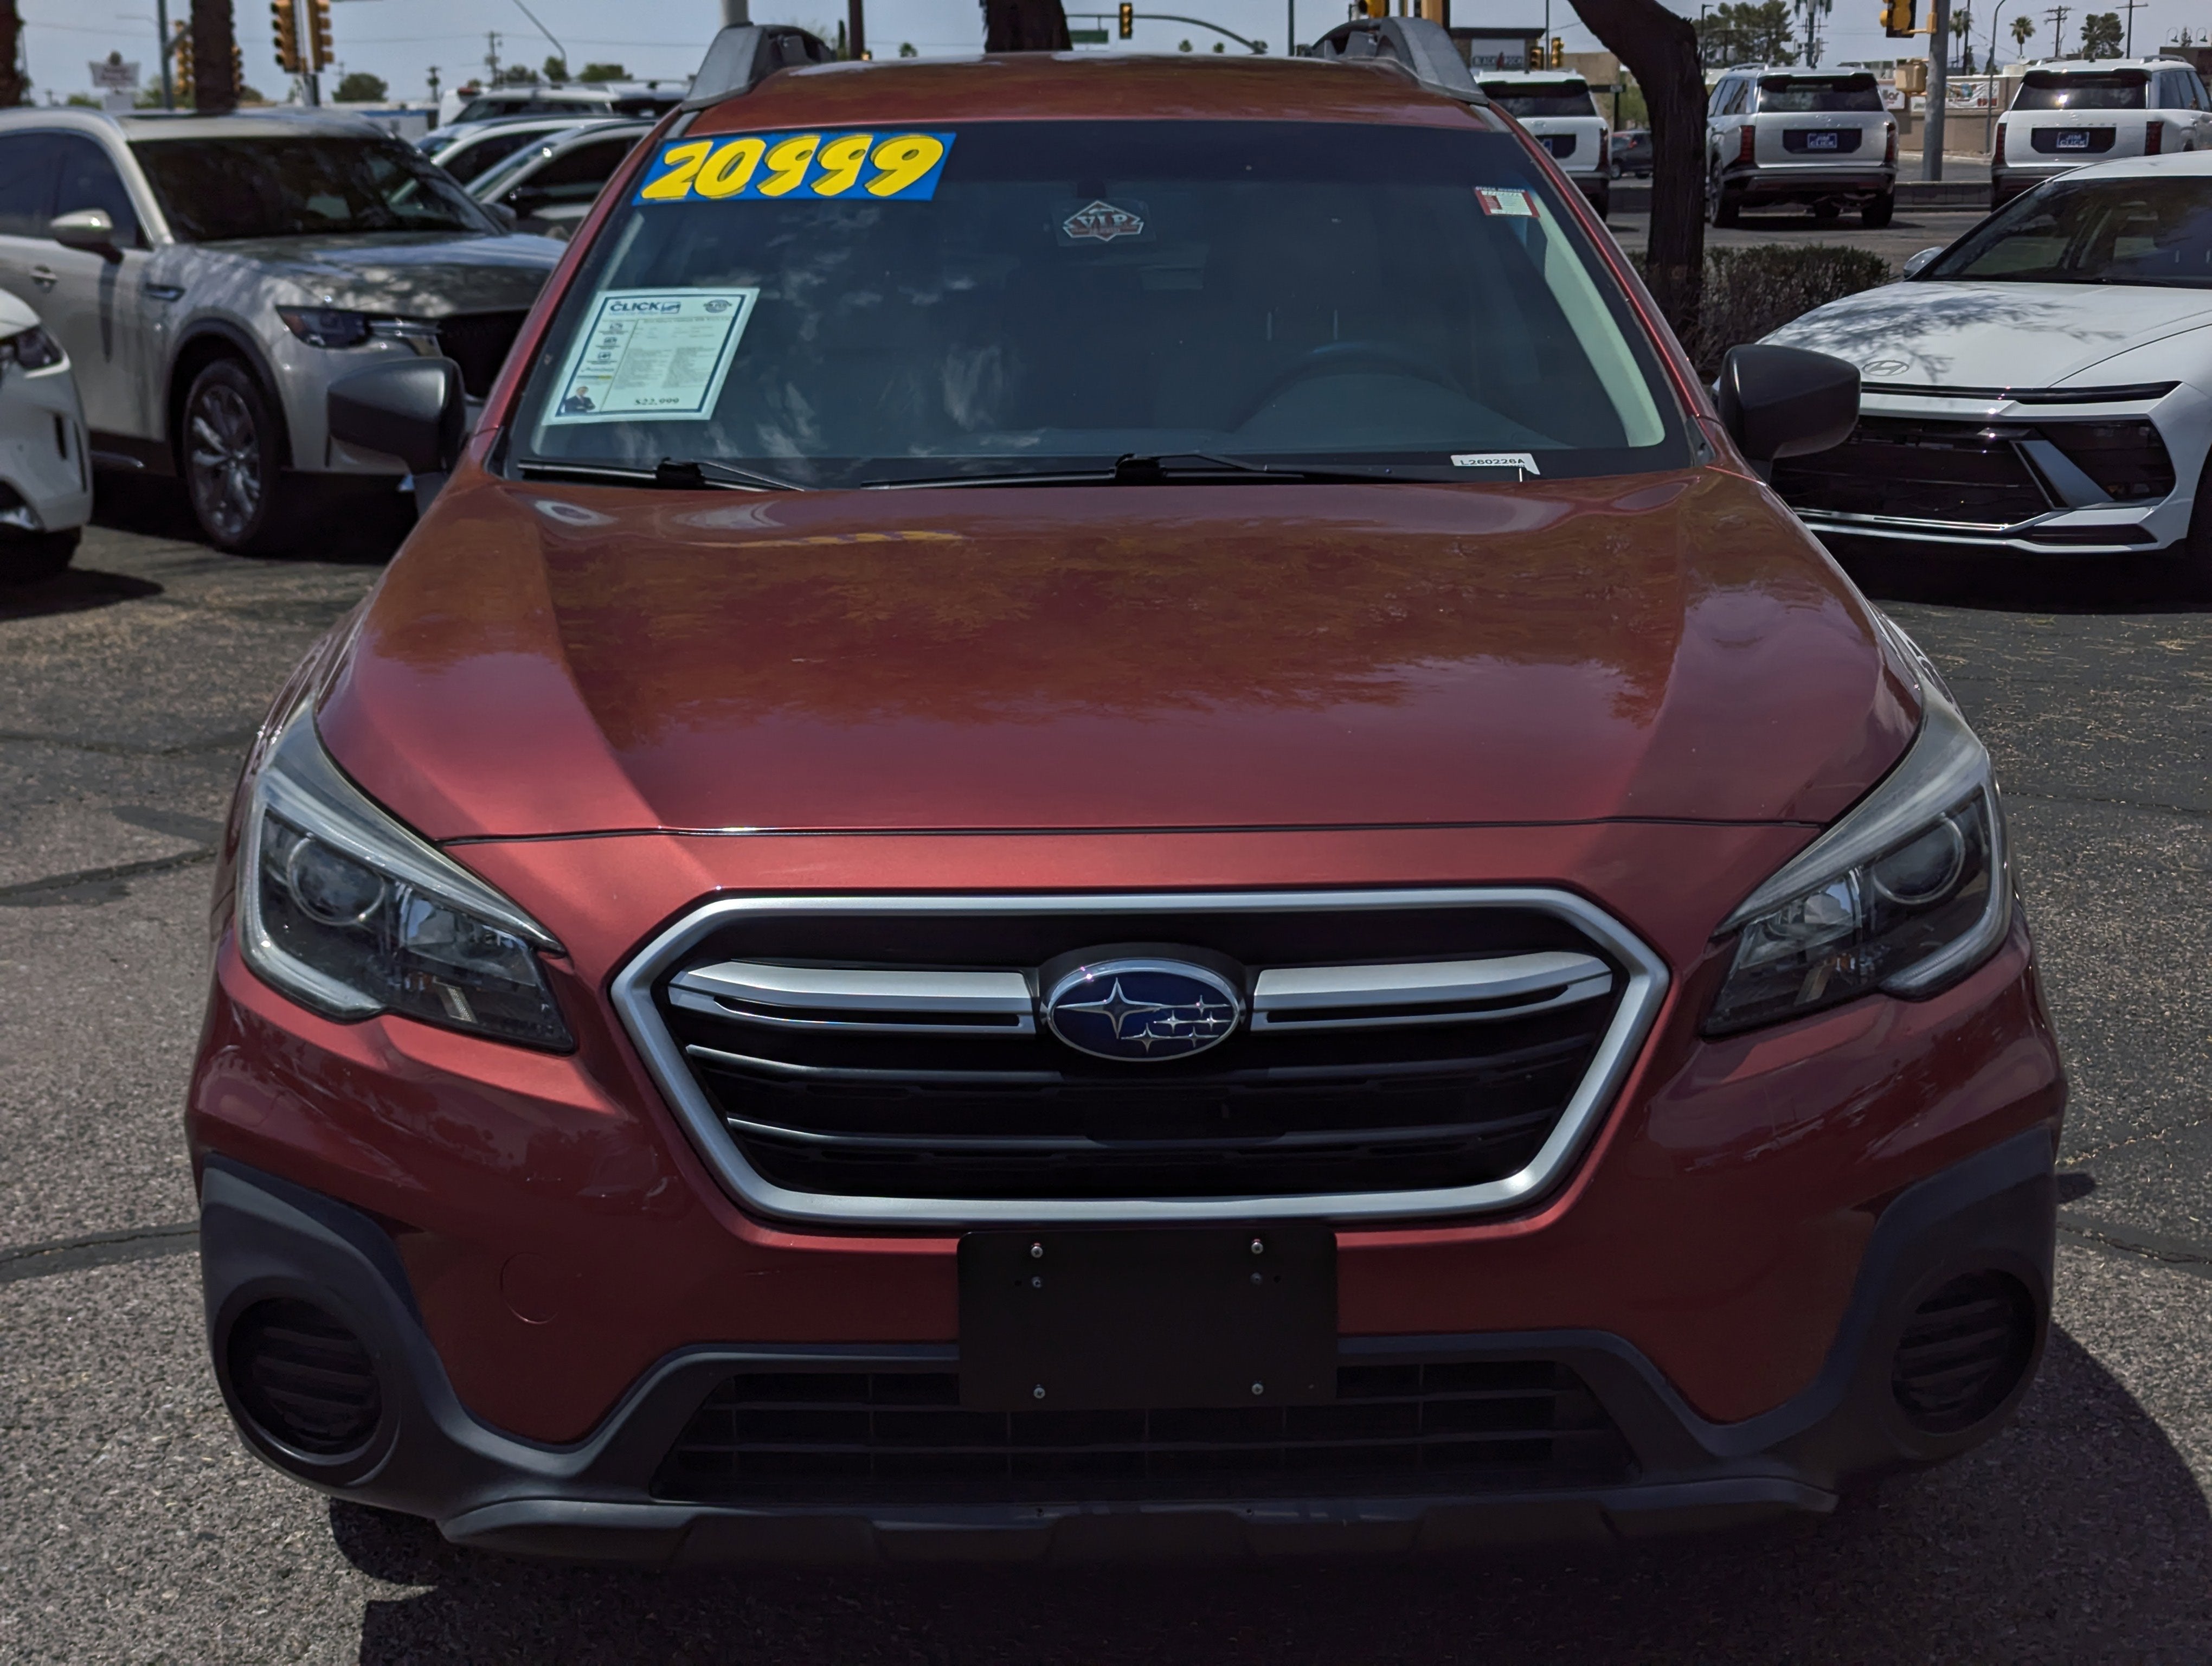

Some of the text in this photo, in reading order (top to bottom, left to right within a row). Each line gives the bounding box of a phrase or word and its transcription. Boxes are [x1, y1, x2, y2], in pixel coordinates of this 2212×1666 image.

[641, 135, 944, 199] 20999
[1077, 214, 1128, 227] VIP
[610, 302, 660, 311] CLICK
